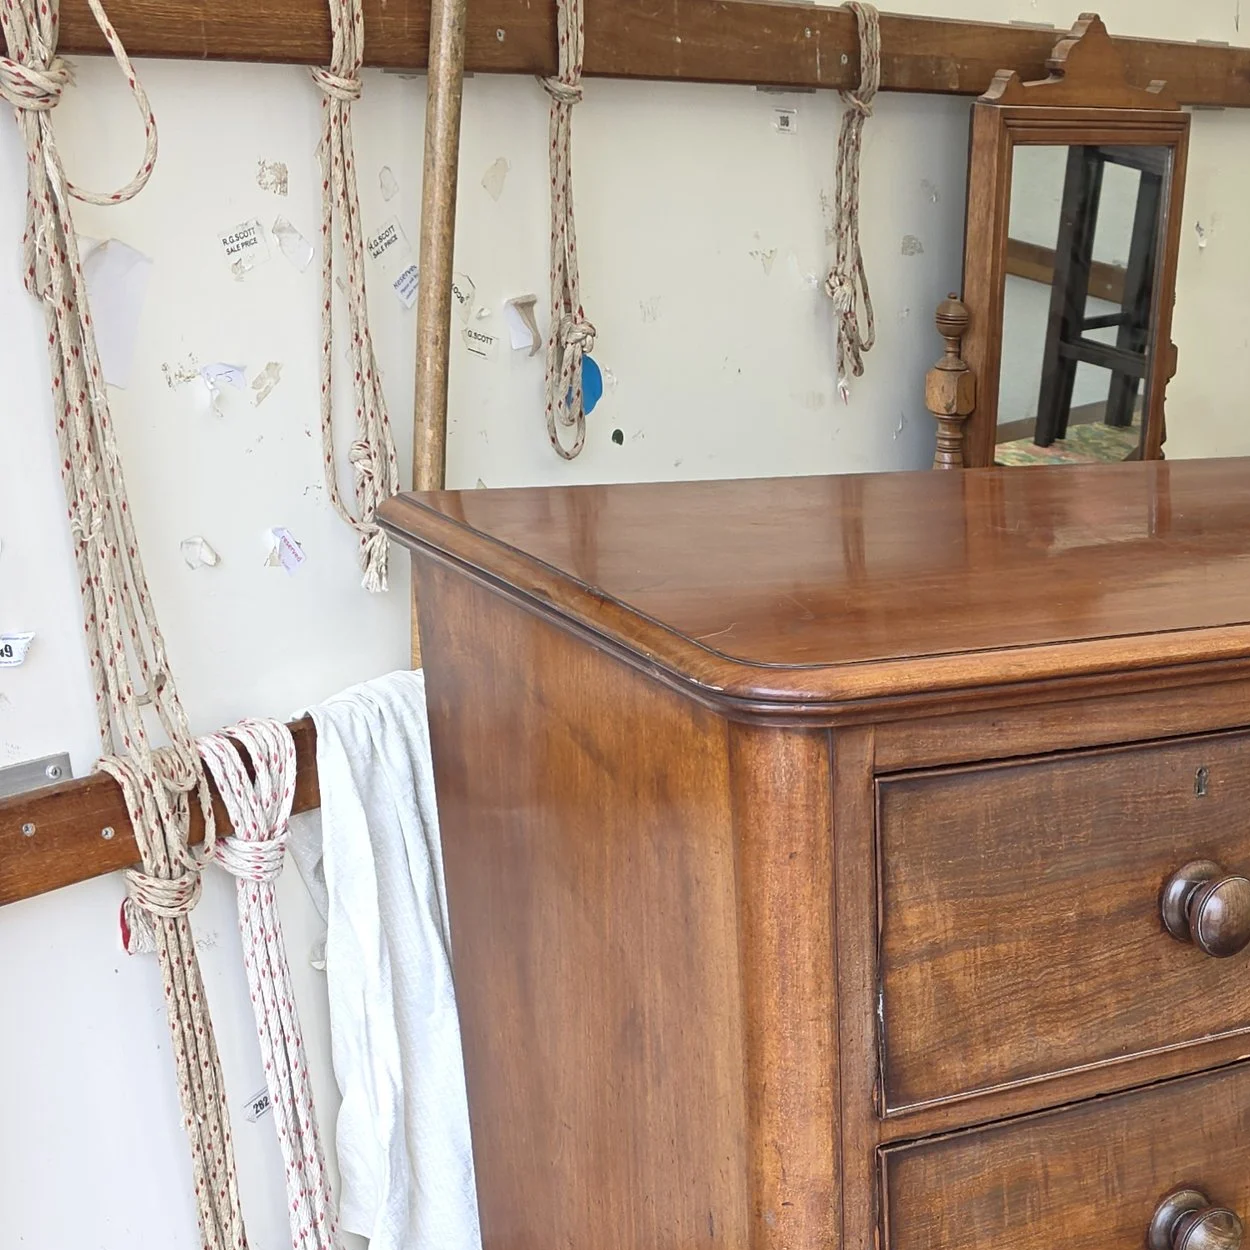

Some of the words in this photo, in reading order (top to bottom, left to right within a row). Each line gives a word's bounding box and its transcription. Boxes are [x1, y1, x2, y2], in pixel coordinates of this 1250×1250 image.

[226, 244, 241, 255] SALE
[241, 237, 258, 248] PRICE
[372, 245, 385, 259] SALE
[384, 234, 398, 249] PRICE
[253, 1096, 269, 1114] 282
